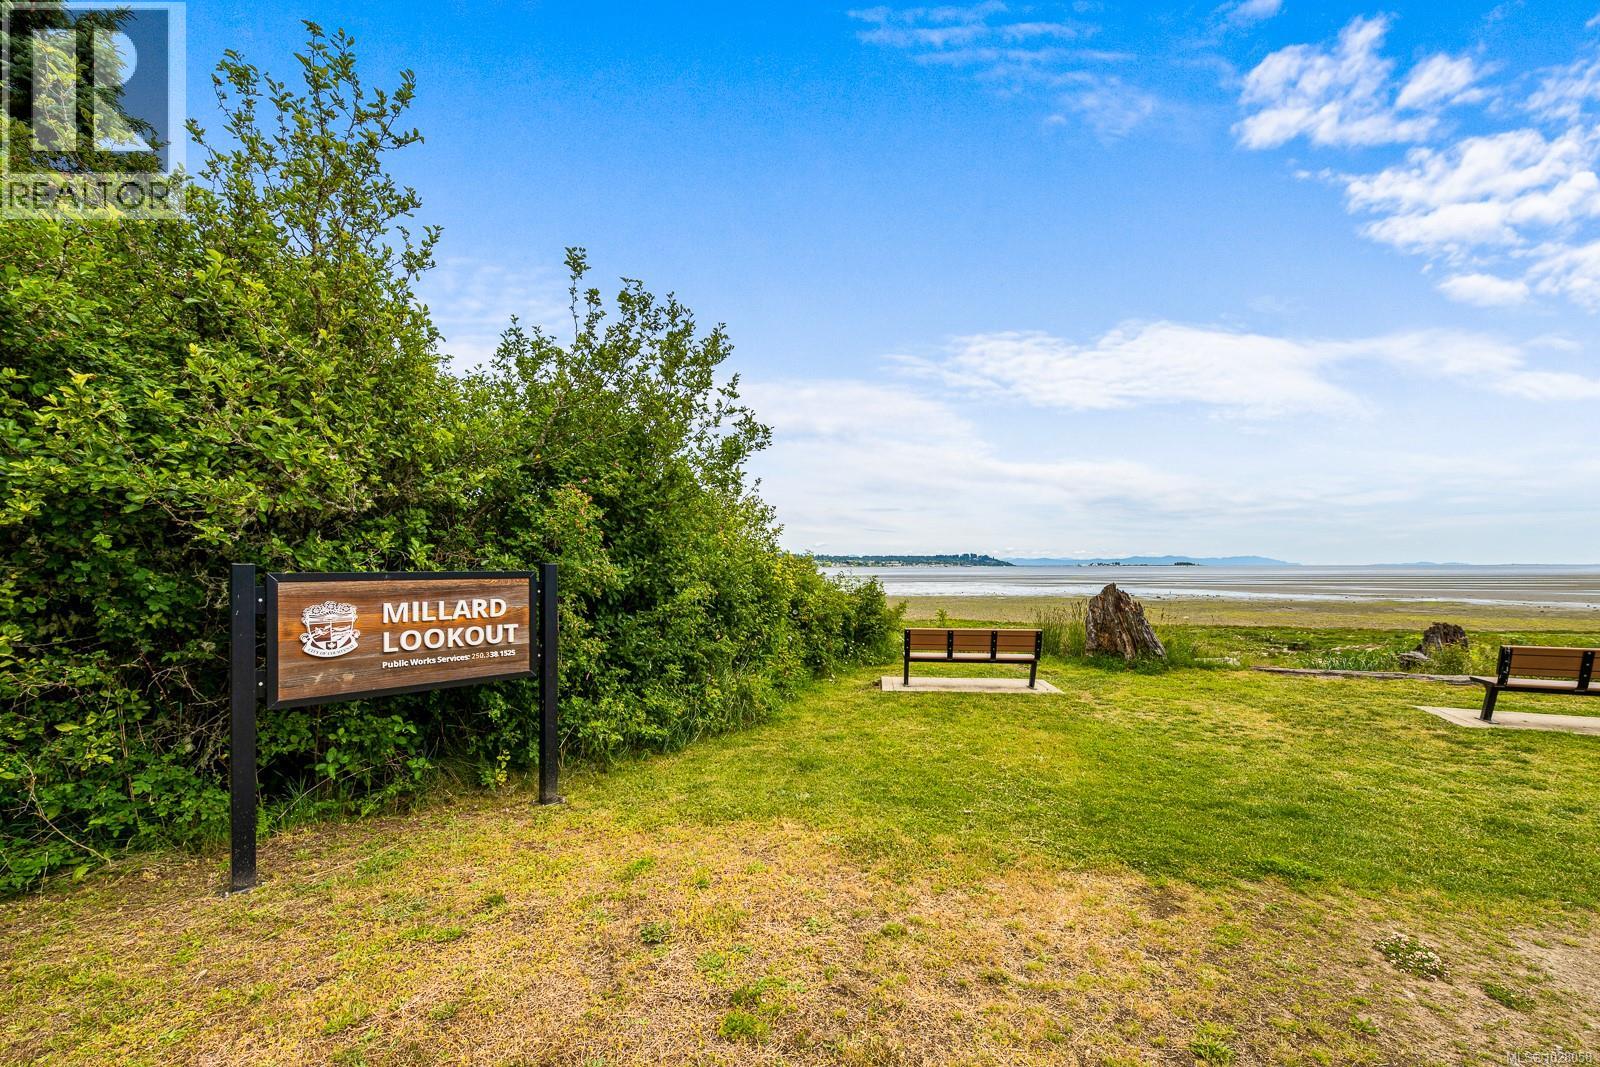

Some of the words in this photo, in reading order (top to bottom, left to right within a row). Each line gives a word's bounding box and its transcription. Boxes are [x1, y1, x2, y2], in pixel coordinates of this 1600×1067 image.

[382, 599, 507, 624] MILLARD
[383, 624, 519, 653] LOOKOUT
[382, 659, 409, 669] Public
[409, 657, 437, 666] Works
[436, 654, 471, 664] Services:
[471, 649, 516, 660] 250.338.1525
